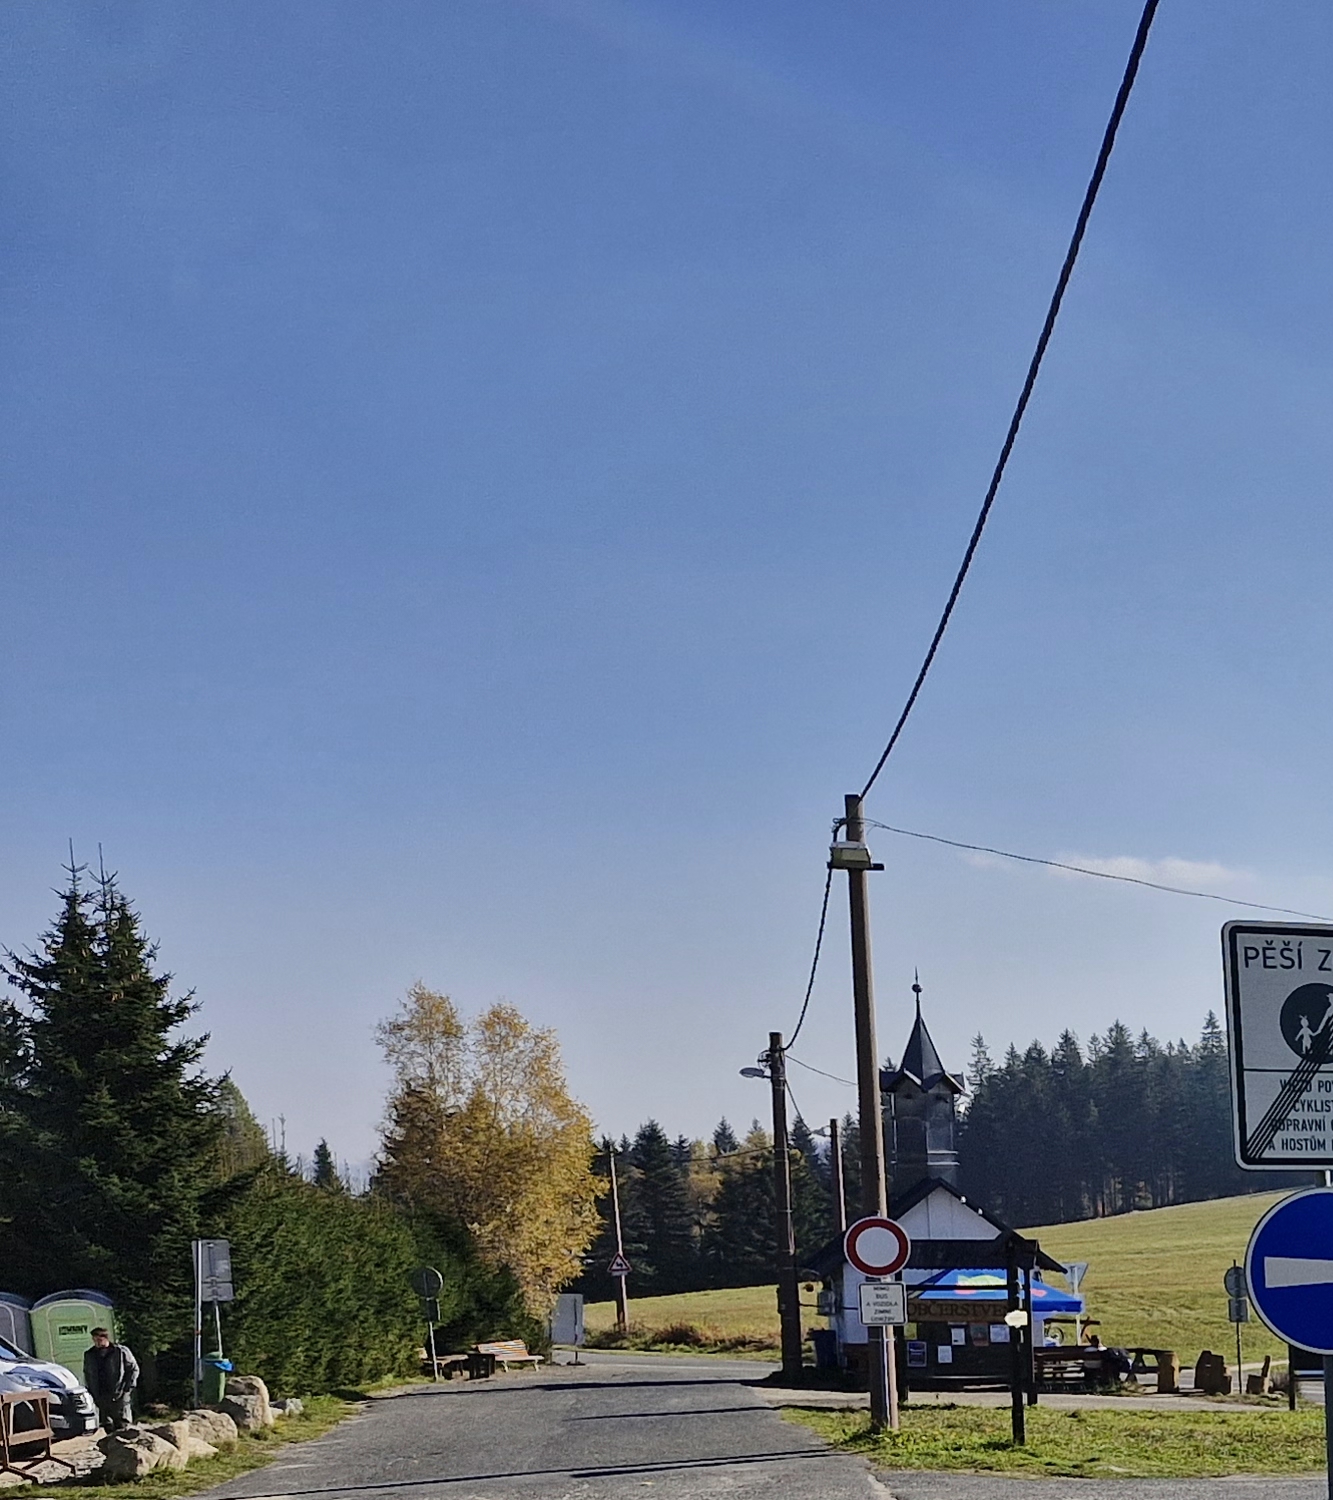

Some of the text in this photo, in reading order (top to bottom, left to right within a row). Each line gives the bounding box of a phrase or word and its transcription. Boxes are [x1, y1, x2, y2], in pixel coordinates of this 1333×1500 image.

[1243, 940, 1303, 970] PĚŠÍ
[1268, 1139, 1276, 1151] A
[1281, 1136, 1327, 1151] HOSTŮM
